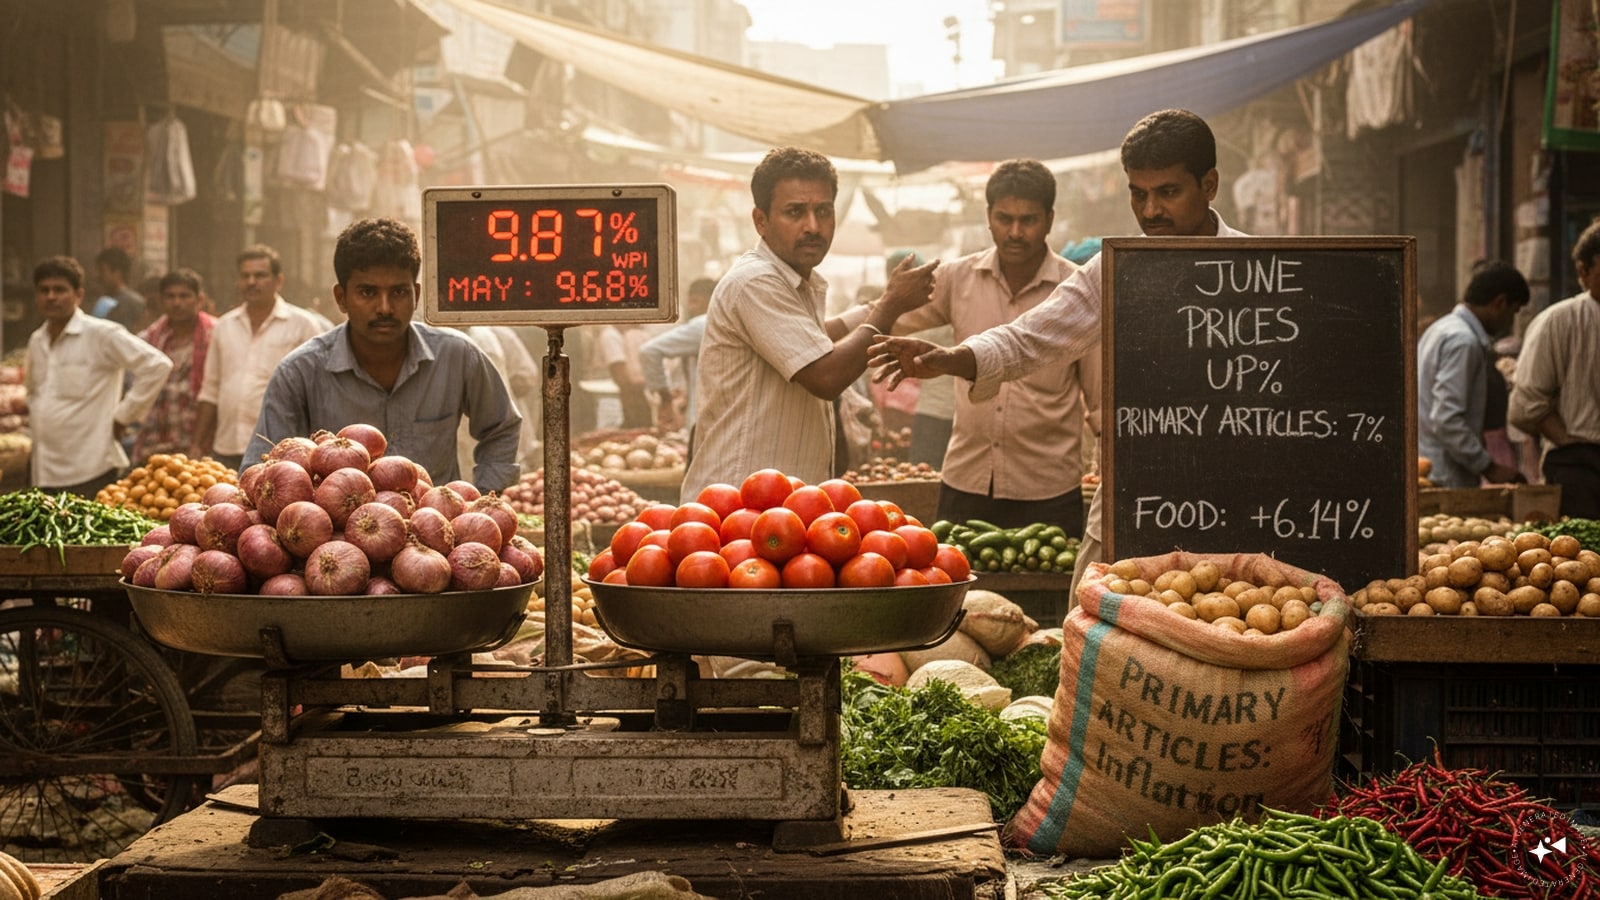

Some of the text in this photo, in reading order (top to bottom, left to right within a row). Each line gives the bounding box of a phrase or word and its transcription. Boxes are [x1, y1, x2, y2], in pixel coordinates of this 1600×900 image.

[487, 209, 639, 262] 9.87%
[611, 252, 648, 269] WPI
[1194, 254, 1304, 296] JUNE
[556, 270, 649, 303] 9.68%
[1177, 305, 1300, 348] PRICES
[1206, 355, 1283, 394] UP%
[1116, 404, 1385, 442] PRIMARY ARTICLES: 7%
[1135, 496, 1375, 540] FOOD: +6.14%
[1119, 656, 1285, 725] PRIMARY
[1097, 700, 1271, 773] ARTICLES:
